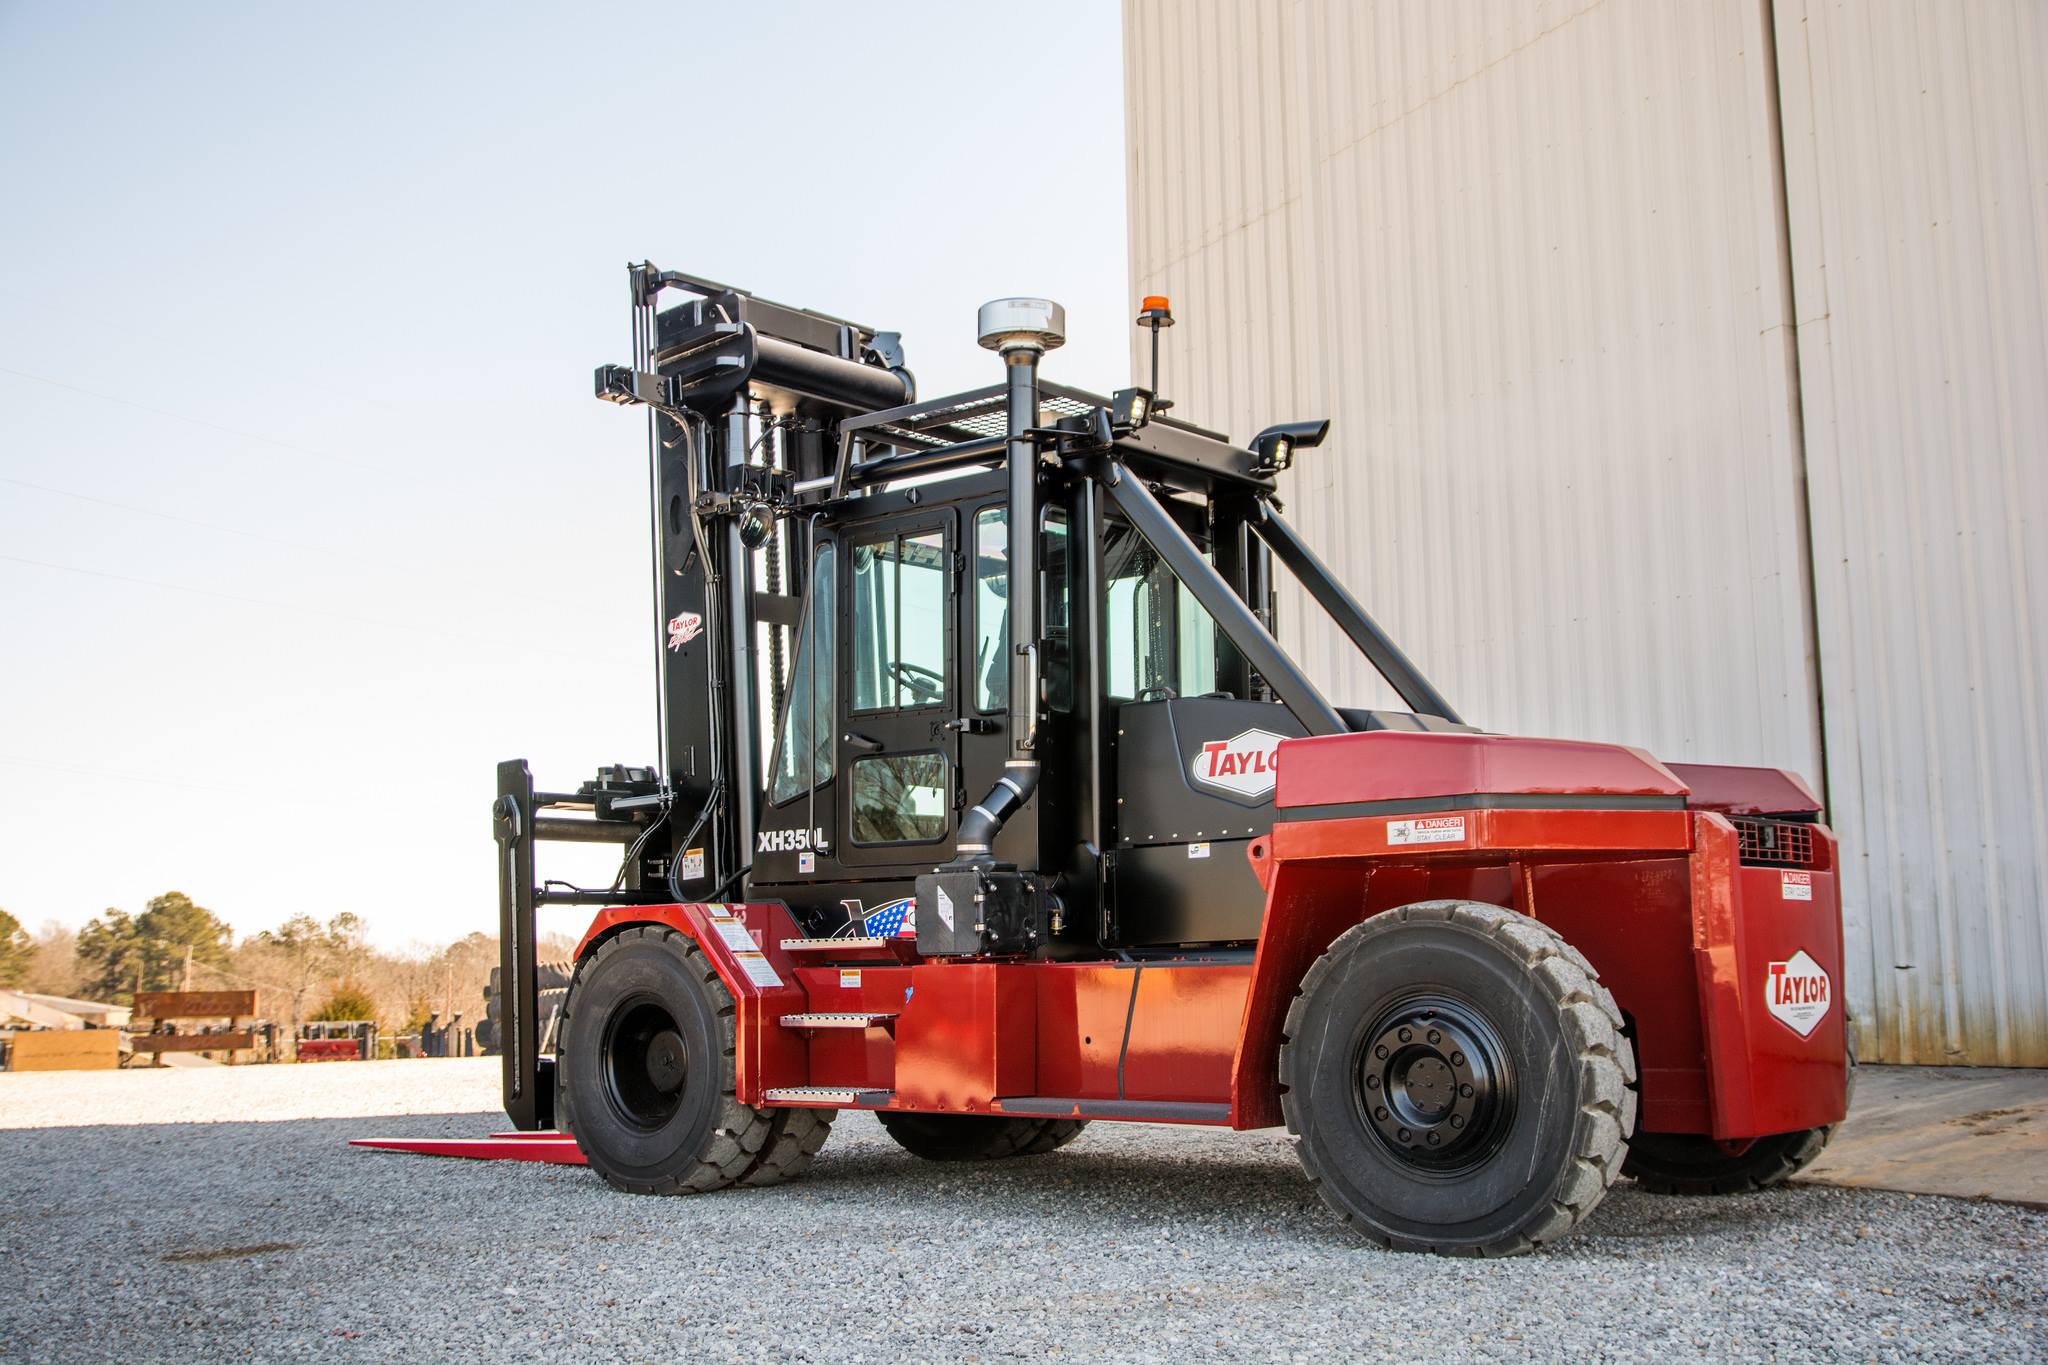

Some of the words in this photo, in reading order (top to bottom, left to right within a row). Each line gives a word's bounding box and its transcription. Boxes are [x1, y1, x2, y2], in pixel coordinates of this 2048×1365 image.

[671, 617, 698, 631] TAYLOR
[1204, 742, 1278, 777] TAYLO
[1425, 818, 1461, 828] DANGER
[1788, 872, 1811, 884] DANGER
[1770, 964, 1827, 1005] TAYLOR
